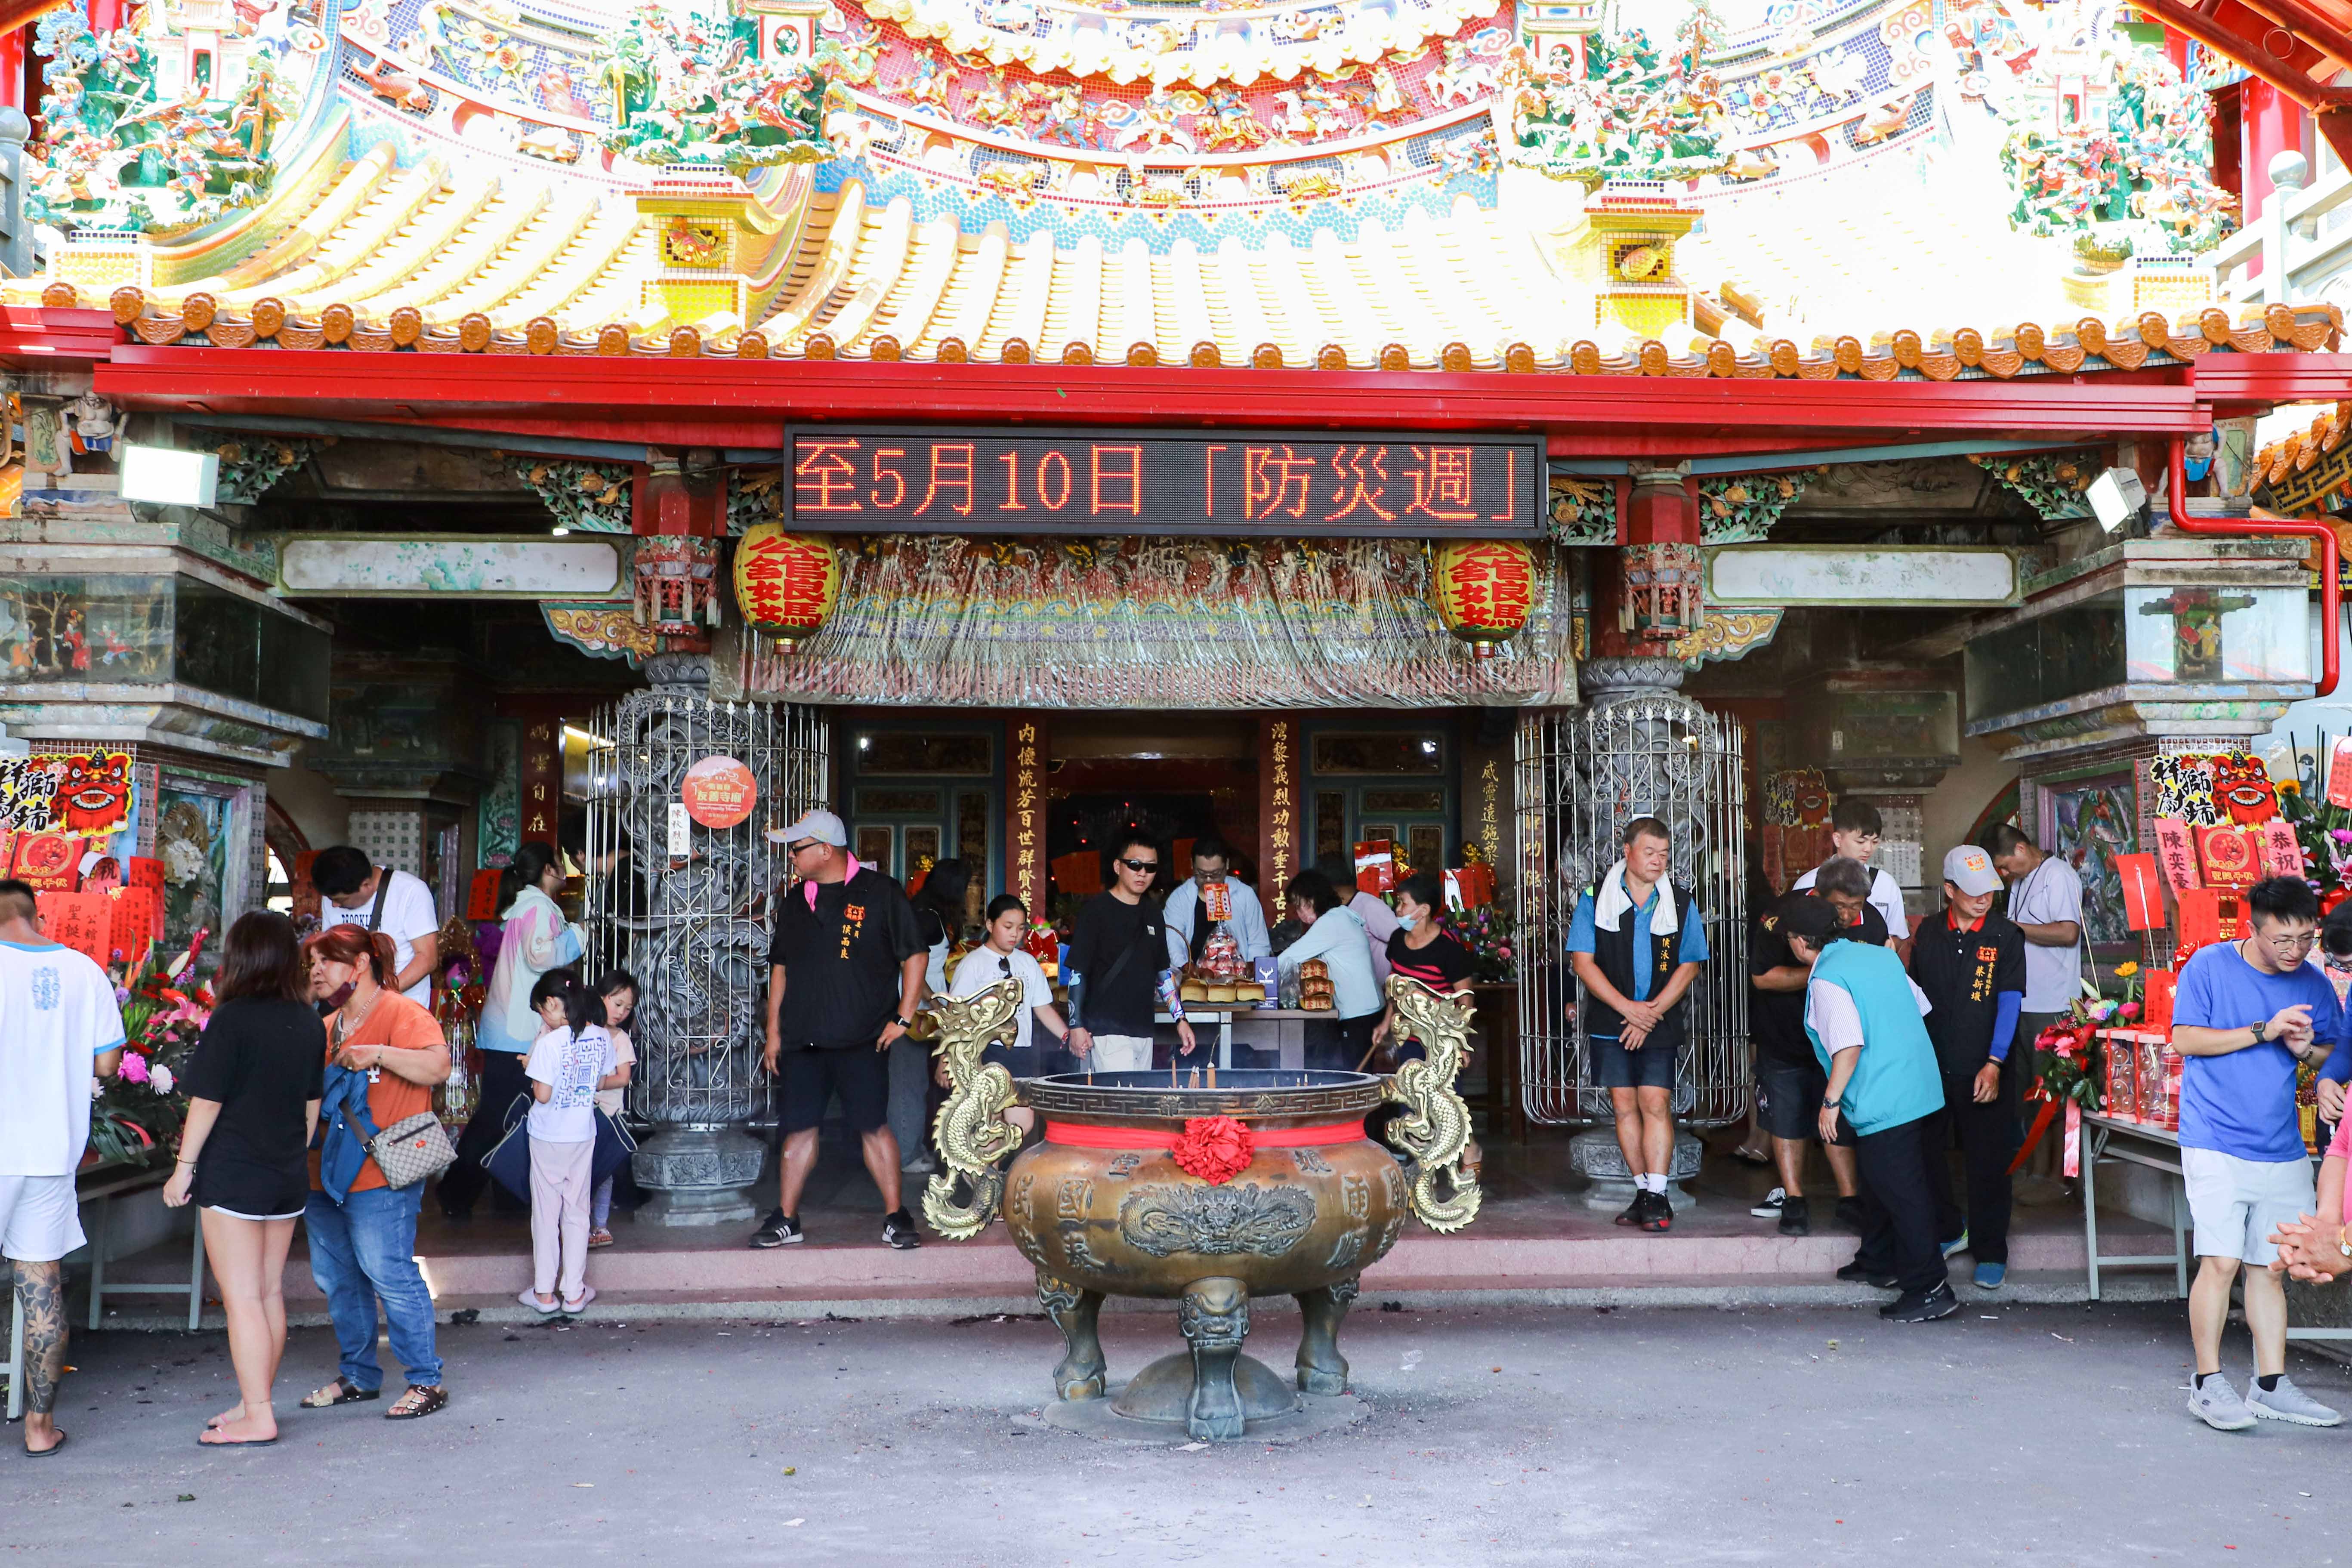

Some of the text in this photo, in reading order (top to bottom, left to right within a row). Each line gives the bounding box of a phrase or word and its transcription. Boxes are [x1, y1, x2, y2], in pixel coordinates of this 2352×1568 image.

[796, 437, 1514, 522] 至5月10日「防災週」
[744, 533, 832, 627] 公館娘媽
[1448, 540, 1530, 630] 公館娘媽
[697, 790, 742, 803] 友善寺廟
[1017, 723, 1038, 924] 內懷流芳百世群賢崇
[1481, 759, 1500, 867] 威靈遠施黎
[102, 861, 117, 879] 祝
[2272, 831, 2299, 871] 恭祝
[1057, 1178, 1106, 1270] 國泰
[1325, 1174, 1371, 1269] 雨順
